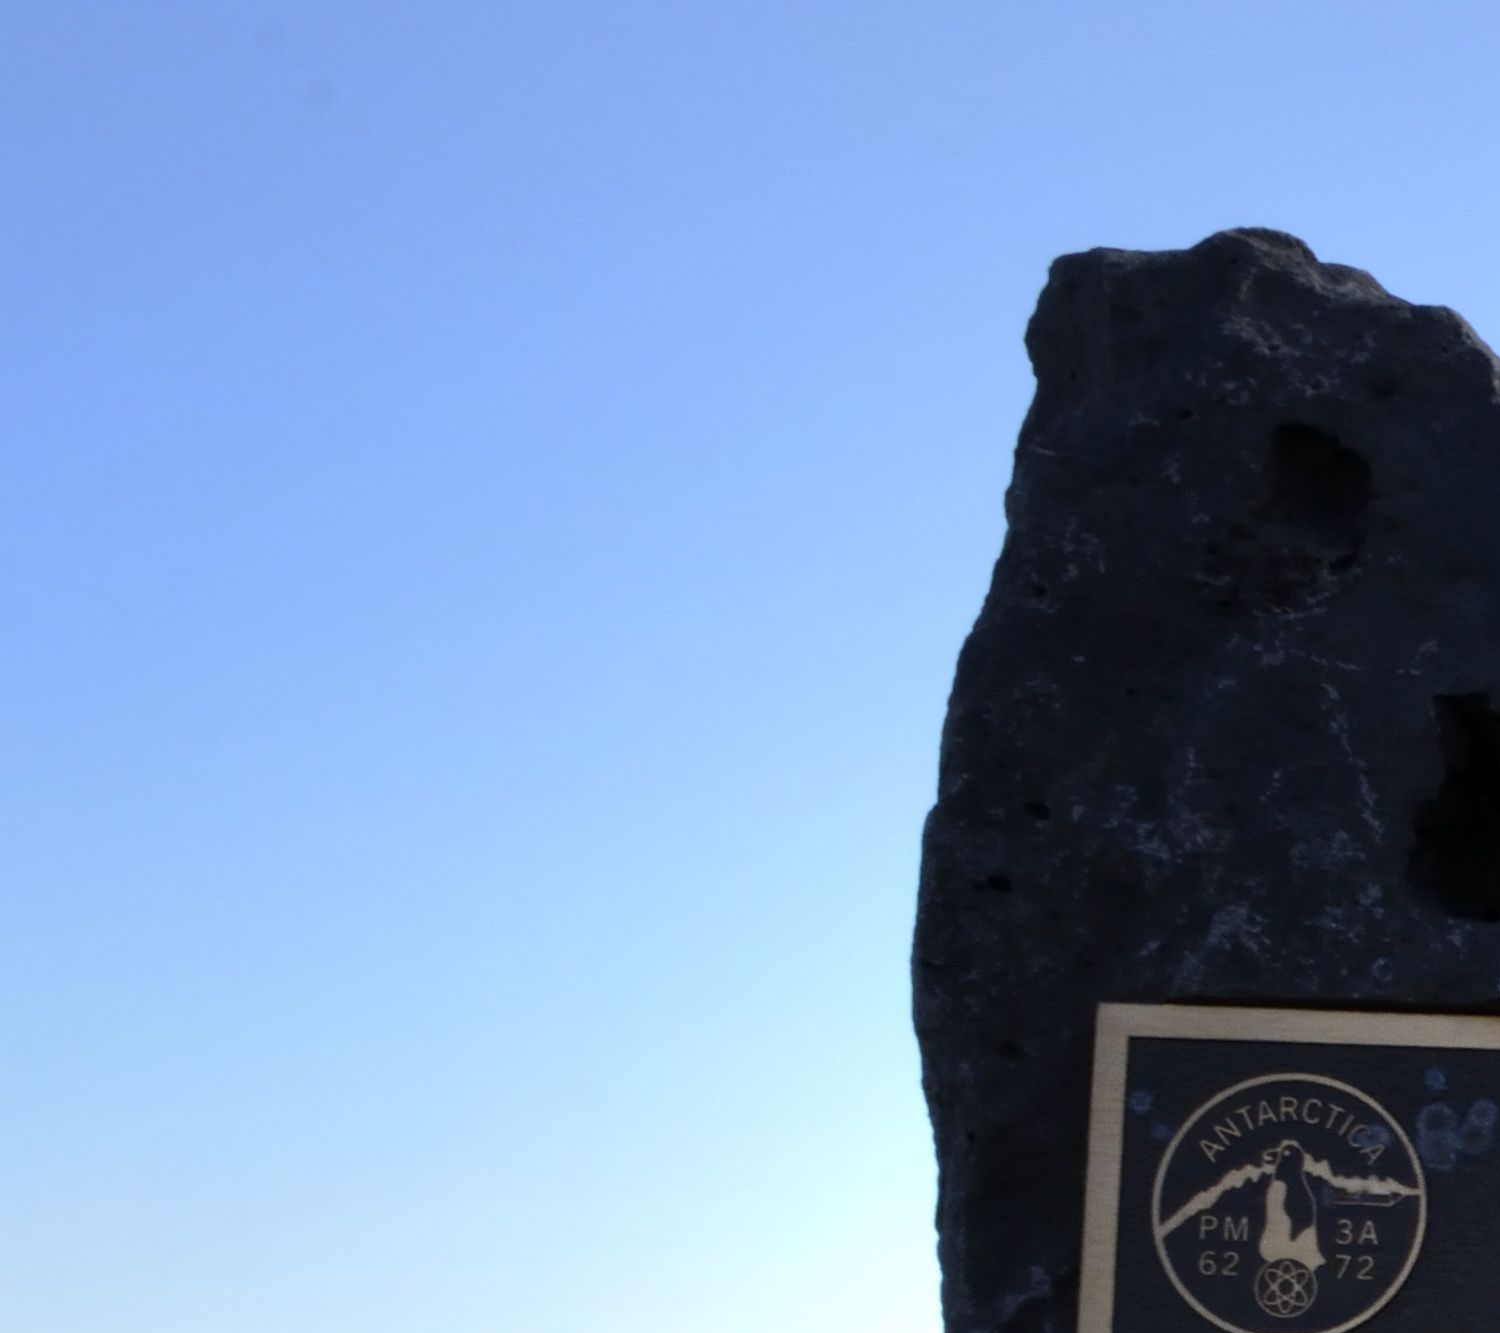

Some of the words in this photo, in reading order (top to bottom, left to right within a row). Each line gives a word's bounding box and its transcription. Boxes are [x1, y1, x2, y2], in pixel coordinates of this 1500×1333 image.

[1199, 1096, 1386, 1166] ANTARCTICA
[1199, 1214, 1250, 1242] PM
[1336, 1219, 1379, 1246] 3A
[1198, 1251, 1240, 1277] 62
[1334, 1256, 1375, 1281] 72
